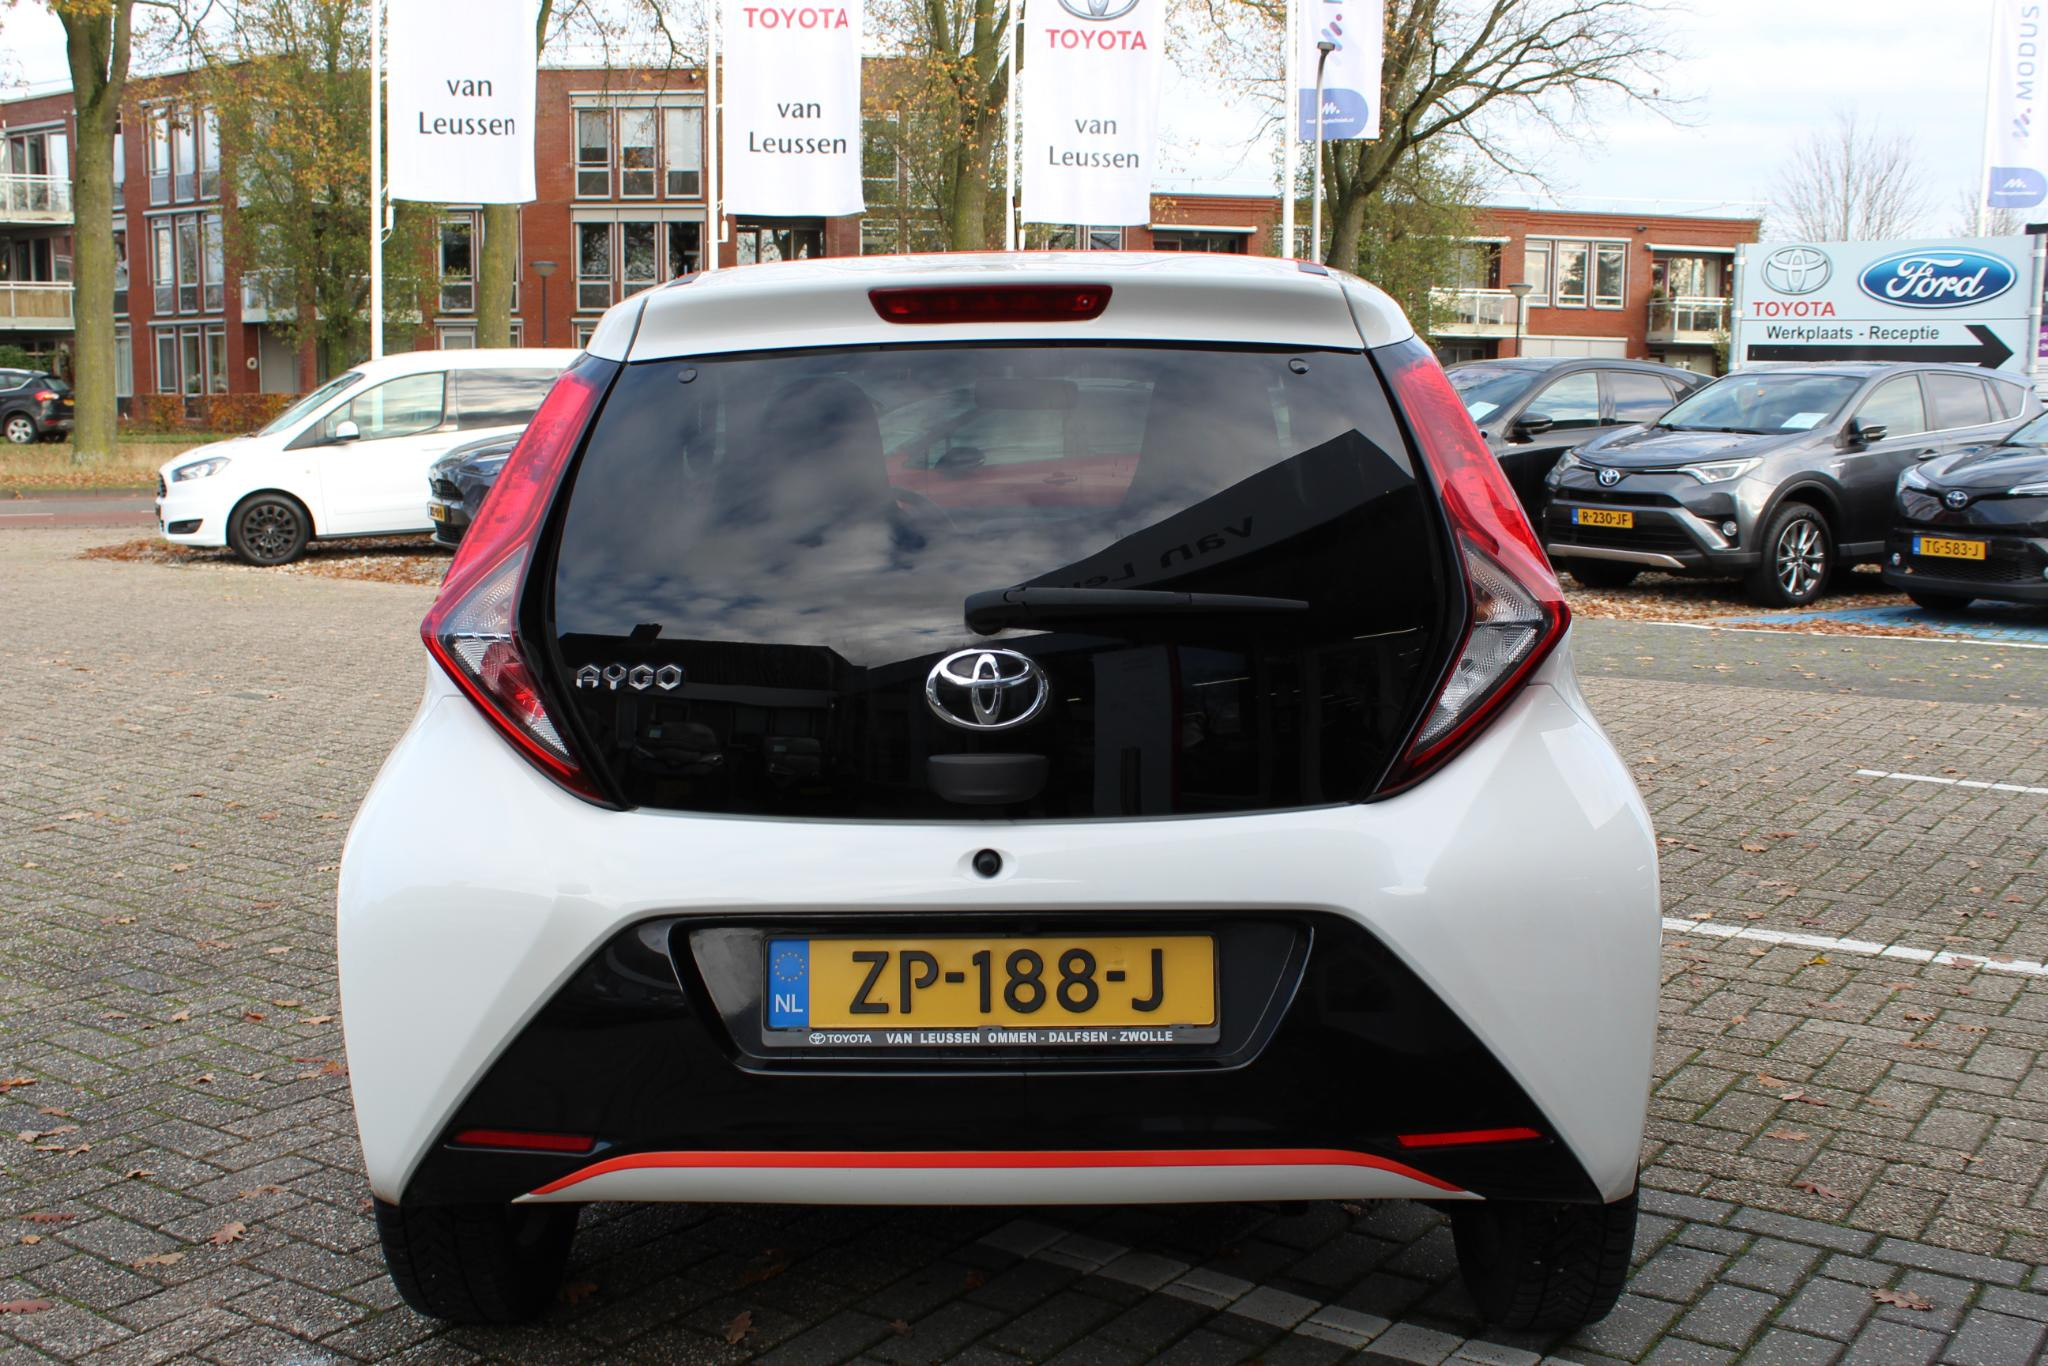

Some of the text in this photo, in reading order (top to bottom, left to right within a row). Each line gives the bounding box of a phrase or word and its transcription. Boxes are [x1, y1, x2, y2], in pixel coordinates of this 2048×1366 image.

[743, 7, 849, 29] TOYOTA
[1045, 28, 1148, 50] TOYOTA
[2016, 5, 2040, 100] MODUS
[447, 79, 493, 97] van
[777, 102, 822, 119] van
[419, 111, 516, 136] Leussen
[1075, 118, 1117, 135] van
[749, 131, 847, 154] Leussen
[1049, 145, 1140, 169] Leussen
[1886, 257, 1988, 298] Ford
[1752, 301, 1836, 317] TOYOTA
[1766, 325, 1854, 343] Werkplaats
[1869, 325, 1940, 343] Receptie
[1582, 511, 1628, 526] R-230-JF
[1924, 540, 1979, 557] TG-583-J
[576, 664, 683, 690] AYGO
[849, 948, 1165, 1015] ZP-188-J
[775, 994, 804, 1013] NL
[827, 1034, 873, 1044] TOYOTA
[886, 1033, 913, 1044] VAN
[920, 1033, 981, 1044] LEUSSEN
[988, 1032, 1037, 1043] OMMEN
[1048, 1031, 1108, 1043] DALFSEN
[1119, 1031, 1174, 1042] ZWOLLE
